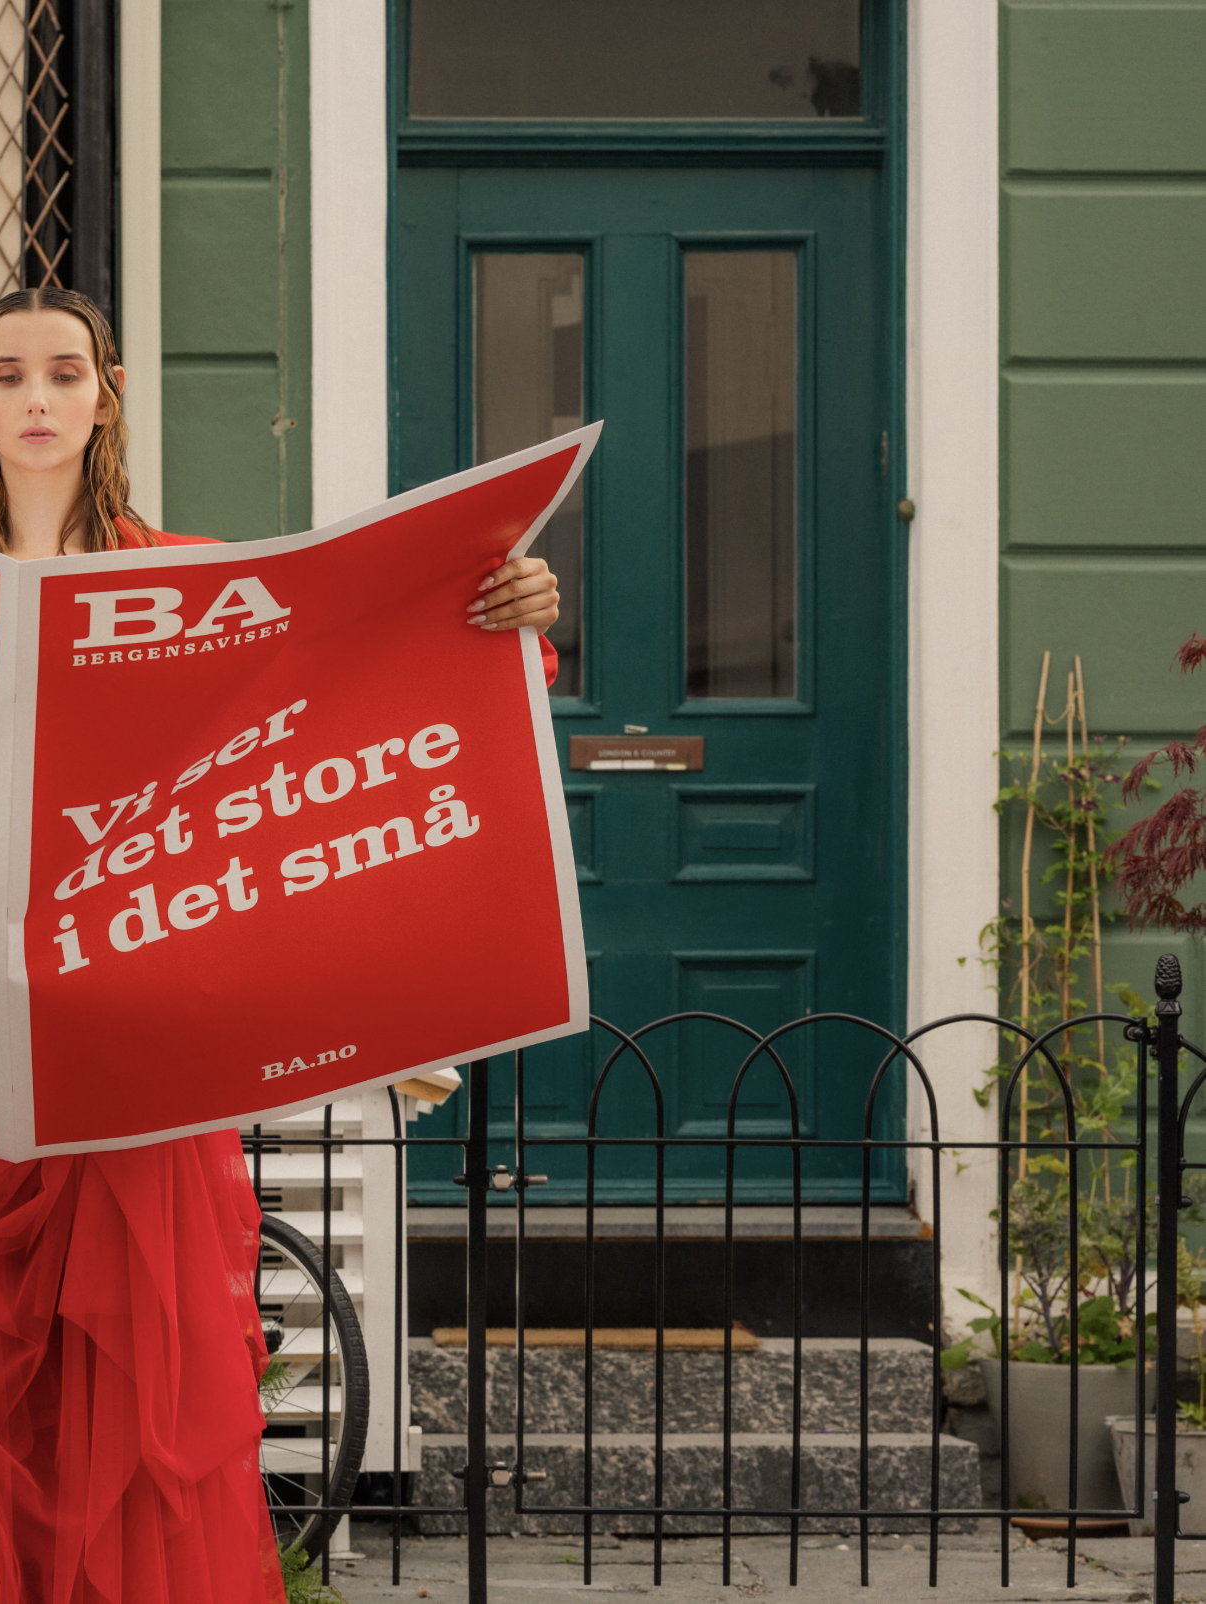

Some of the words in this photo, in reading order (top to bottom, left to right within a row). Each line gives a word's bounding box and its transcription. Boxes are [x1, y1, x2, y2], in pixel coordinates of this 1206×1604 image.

[73, 576, 291, 649] BA
[73, 621, 290, 666] BERGENSAVISEN
[62, 781, 157, 845] Vi
[171, 699, 307, 795] ser
[597, 748, 632, 757] LONDON
[641, 748, 677, 757] COUNTRY
[54, 805, 193, 900] det
[215, 724, 460, 838] store
[53, 914, 90, 974] i
[109, 856, 259, 952] det
[280, 784, 480, 896] små
[261, 1045, 357, 1081] BA.no
